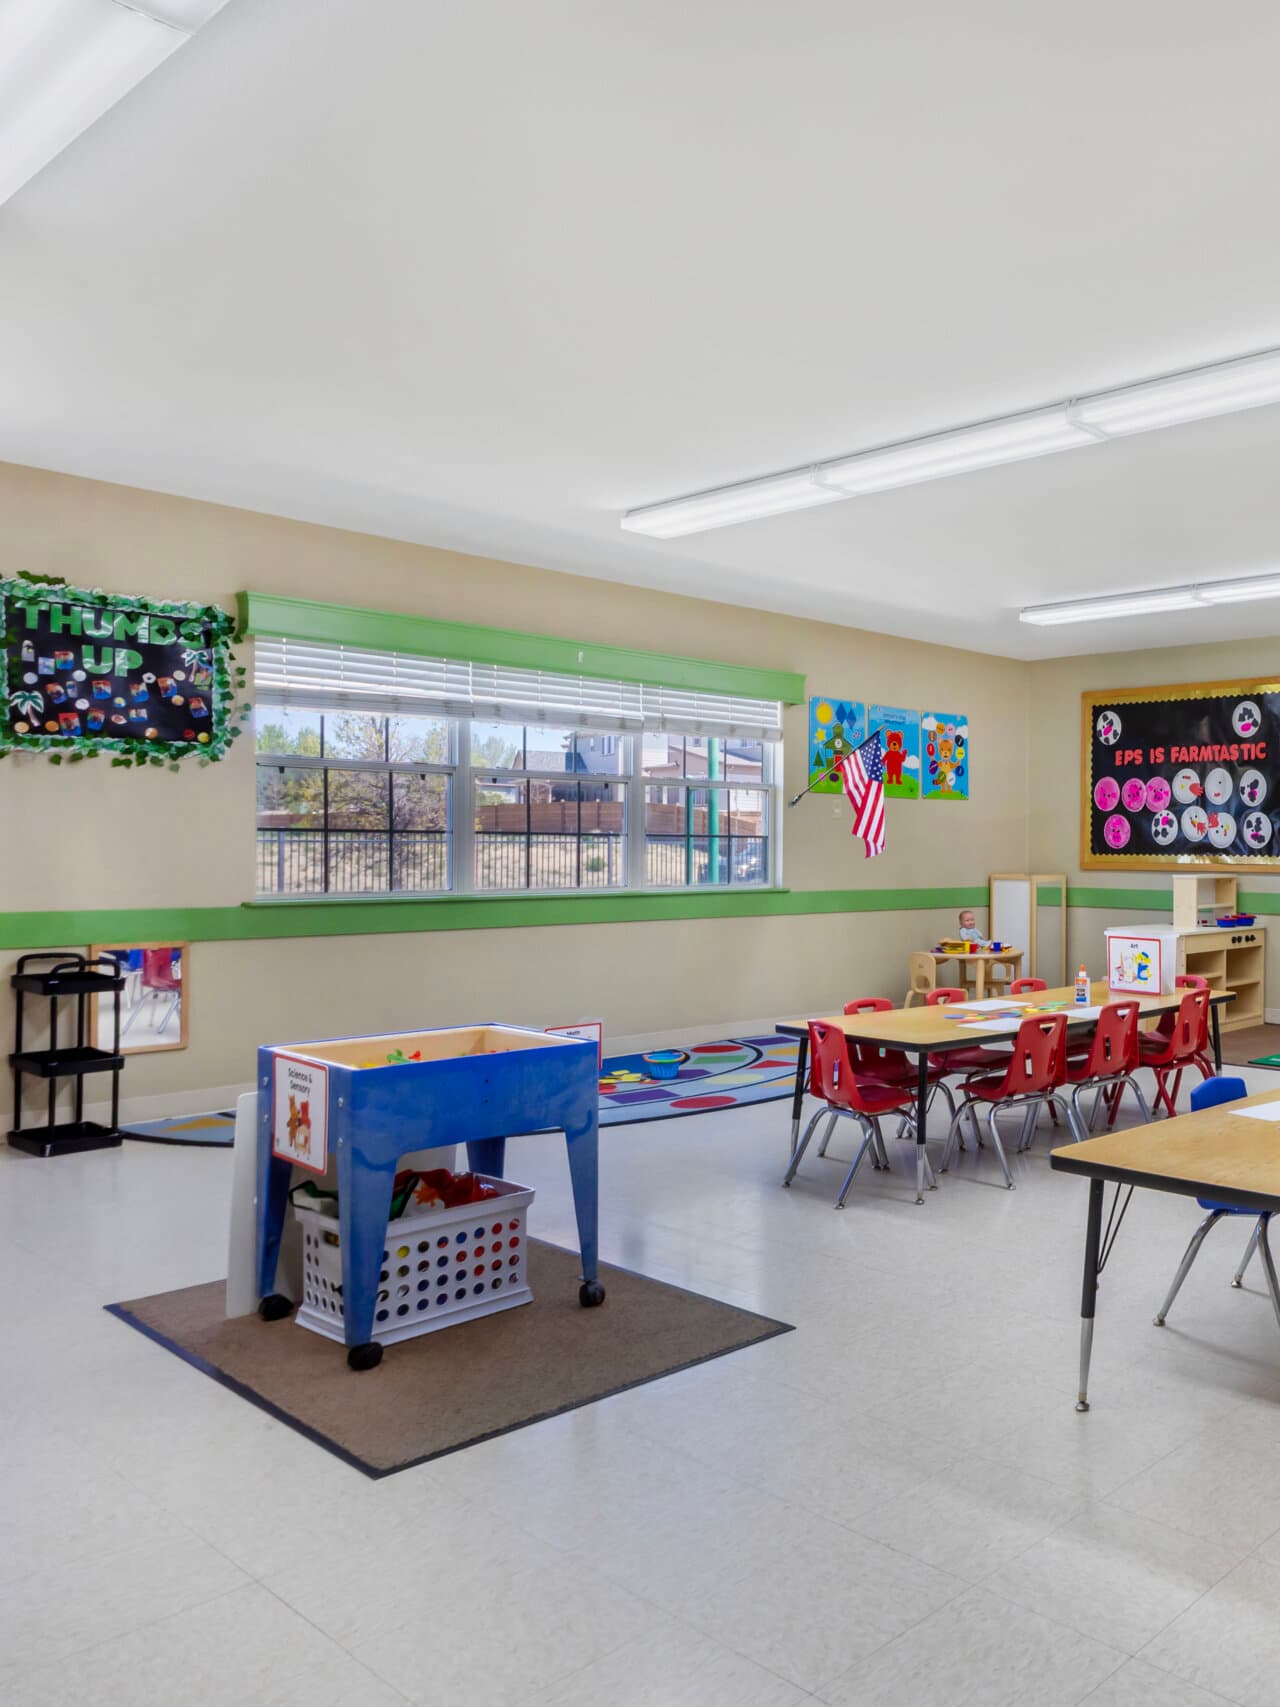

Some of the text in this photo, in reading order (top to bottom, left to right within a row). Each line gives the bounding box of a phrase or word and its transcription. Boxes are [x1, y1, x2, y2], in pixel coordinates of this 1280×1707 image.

[15, 600, 204, 648] THUMBS
[81, 643, 143, 678] UP
[1113, 742, 1268, 766] EPS IS FARMTASTIC
[288, 1067, 307, 1082] Science
[290, 1080, 311, 1097] Sensory
